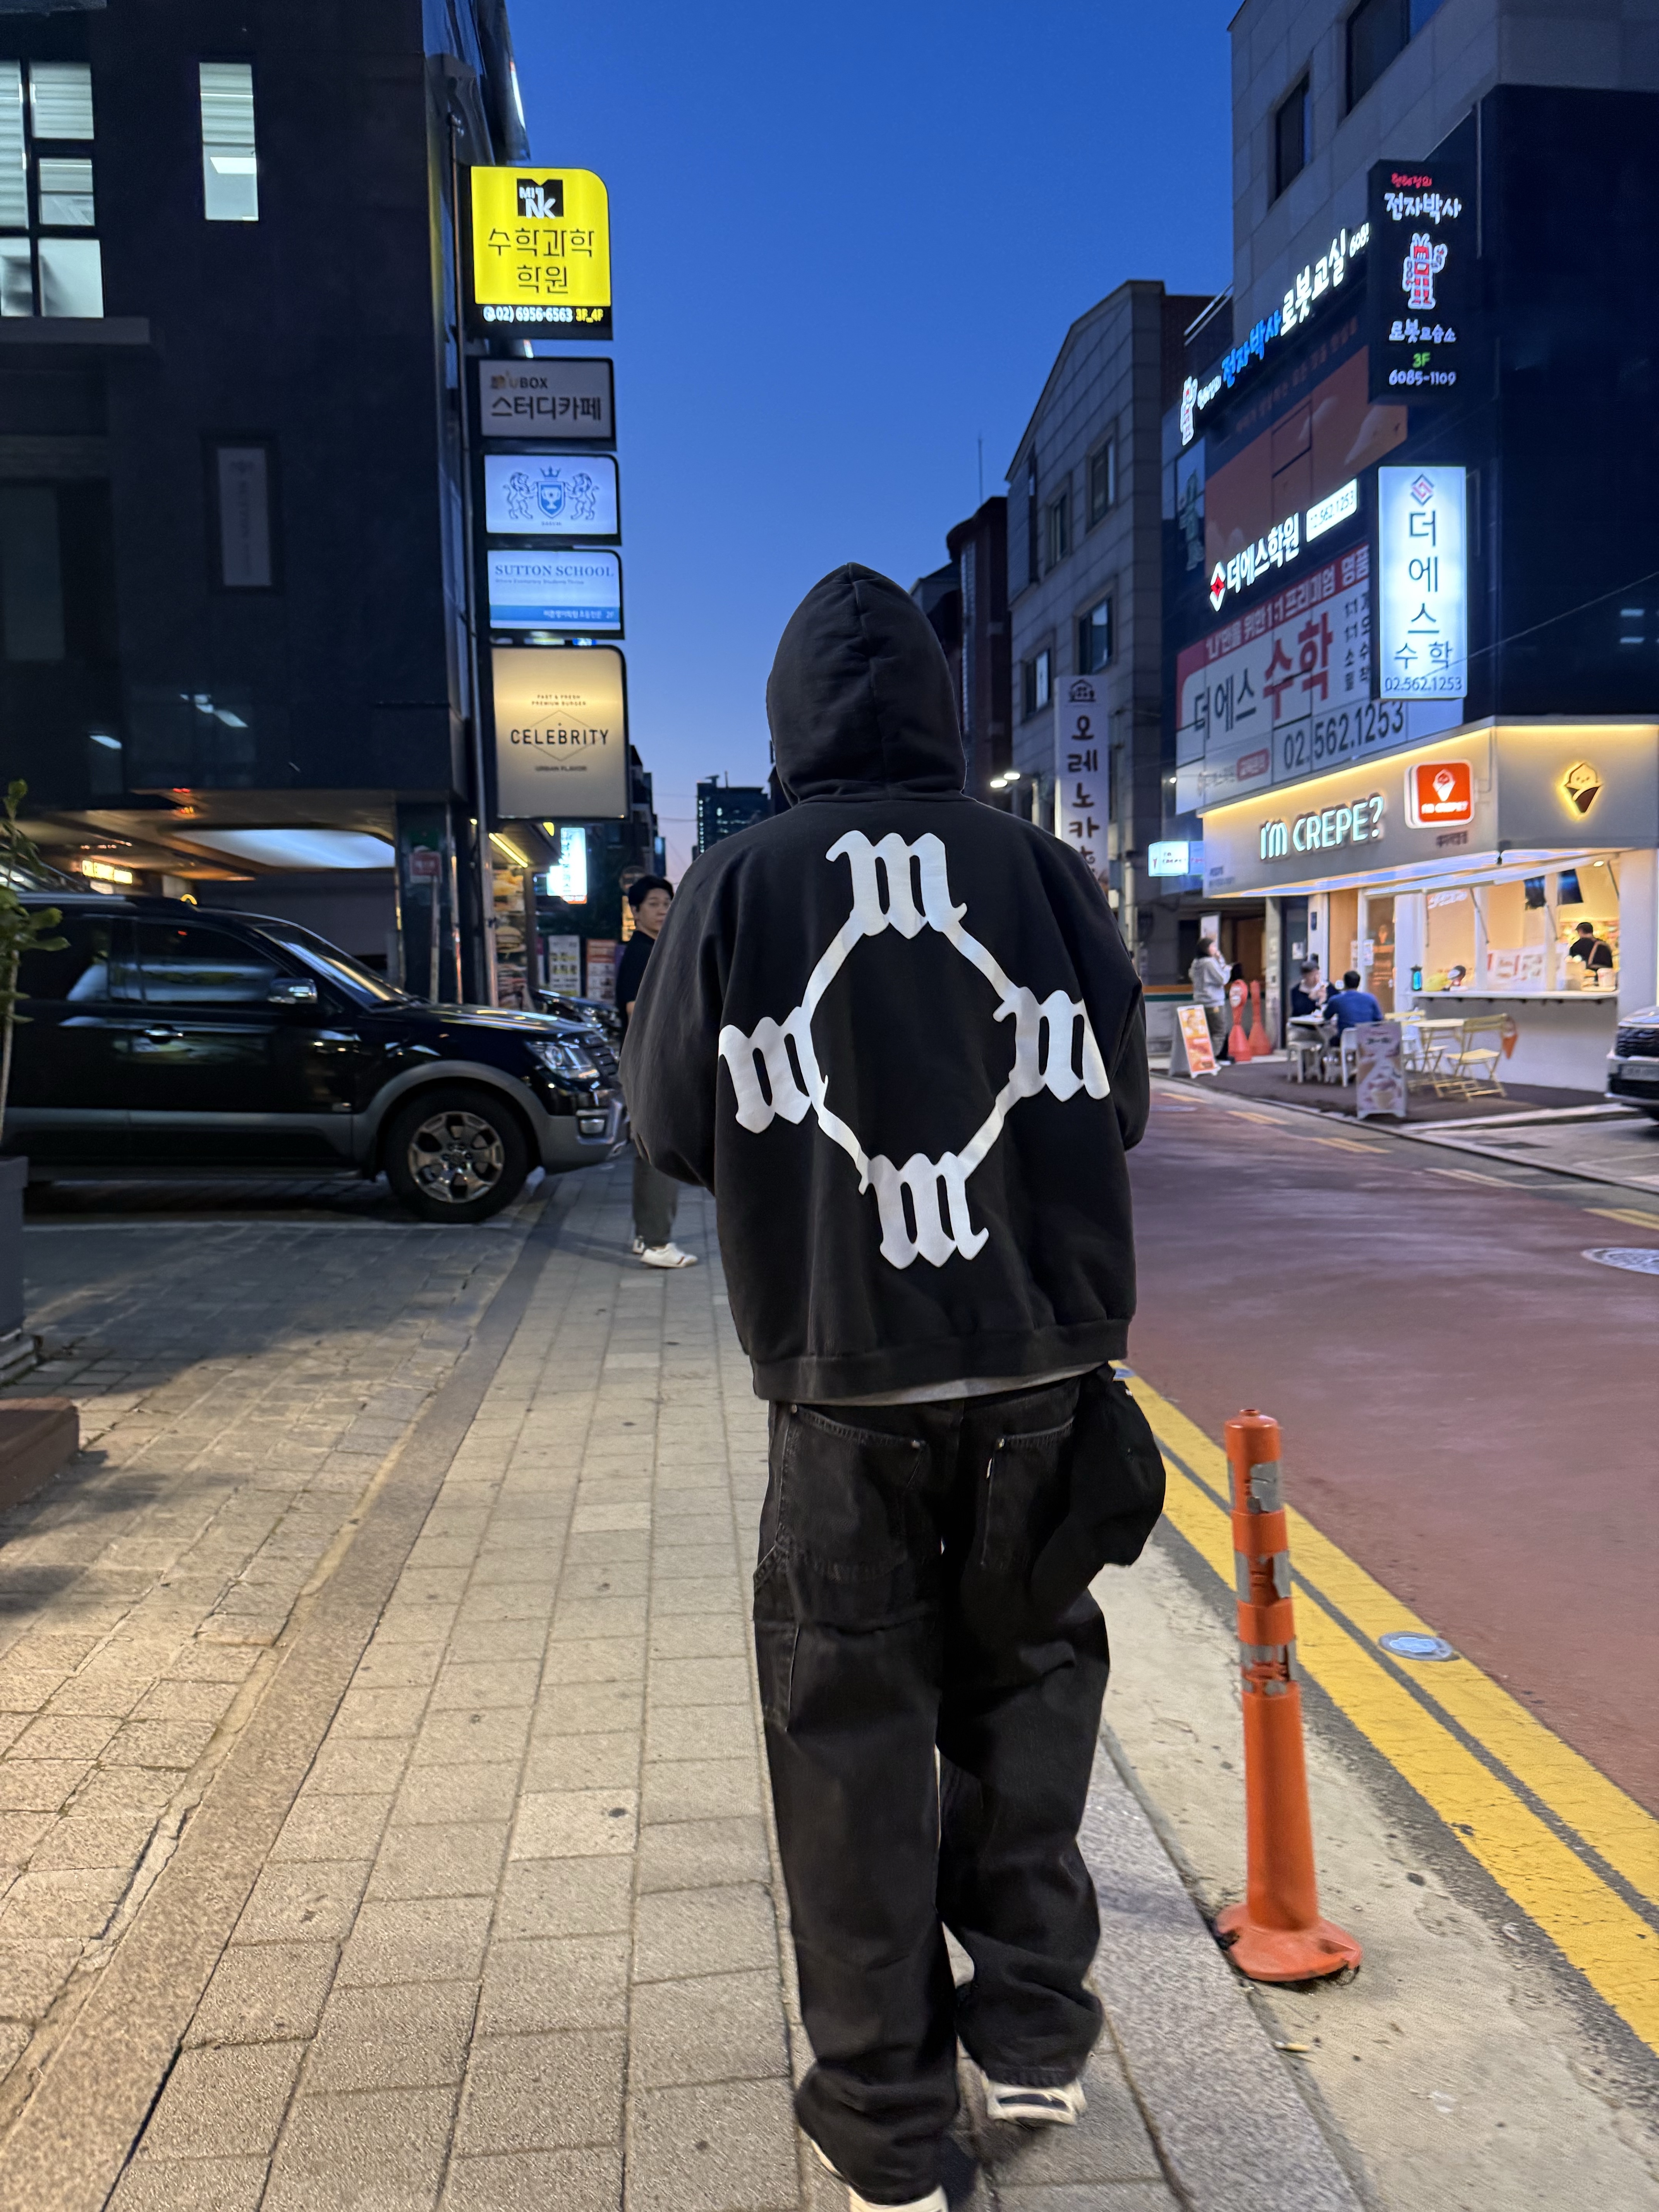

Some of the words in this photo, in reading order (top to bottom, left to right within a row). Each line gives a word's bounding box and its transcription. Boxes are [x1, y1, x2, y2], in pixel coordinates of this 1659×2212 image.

[1384, 192, 1462, 224] 전자박사
[488, 228, 594, 257] 수학과학
[517, 265, 568, 293] 학원
[1221, 310, 1281, 388] 전자박사
[1281, 228, 1345, 336] 로봇교실
[1389, 318, 1456, 344] 로봇교습소
[1412, 352, 1431, 368] 3F
[1389, 369, 1457, 386] 6085-1109
[491, 396, 601, 421] 스터디카페
[1227, 512, 1299, 593] 더에스학원
[495, 565, 551, 576] SUTTON
[556, 566, 614, 577] SCHOOL
[1408, 510, 1439, 634] 더에스
[1394, 641, 1453, 670] 수학
[1194, 668, 1256, 740] 더에스
[1263, 612, 1333, 721] 수학
[1385, 676, 1462, 692] 02.562.1253
[510, 729, 608, 744] CELEBRITY
[1283, 701, 1403, 770] 02.562.1253
[1261, 821, 1288, 860] I'M
[1293, 796, 1384, 852] CREPE?
